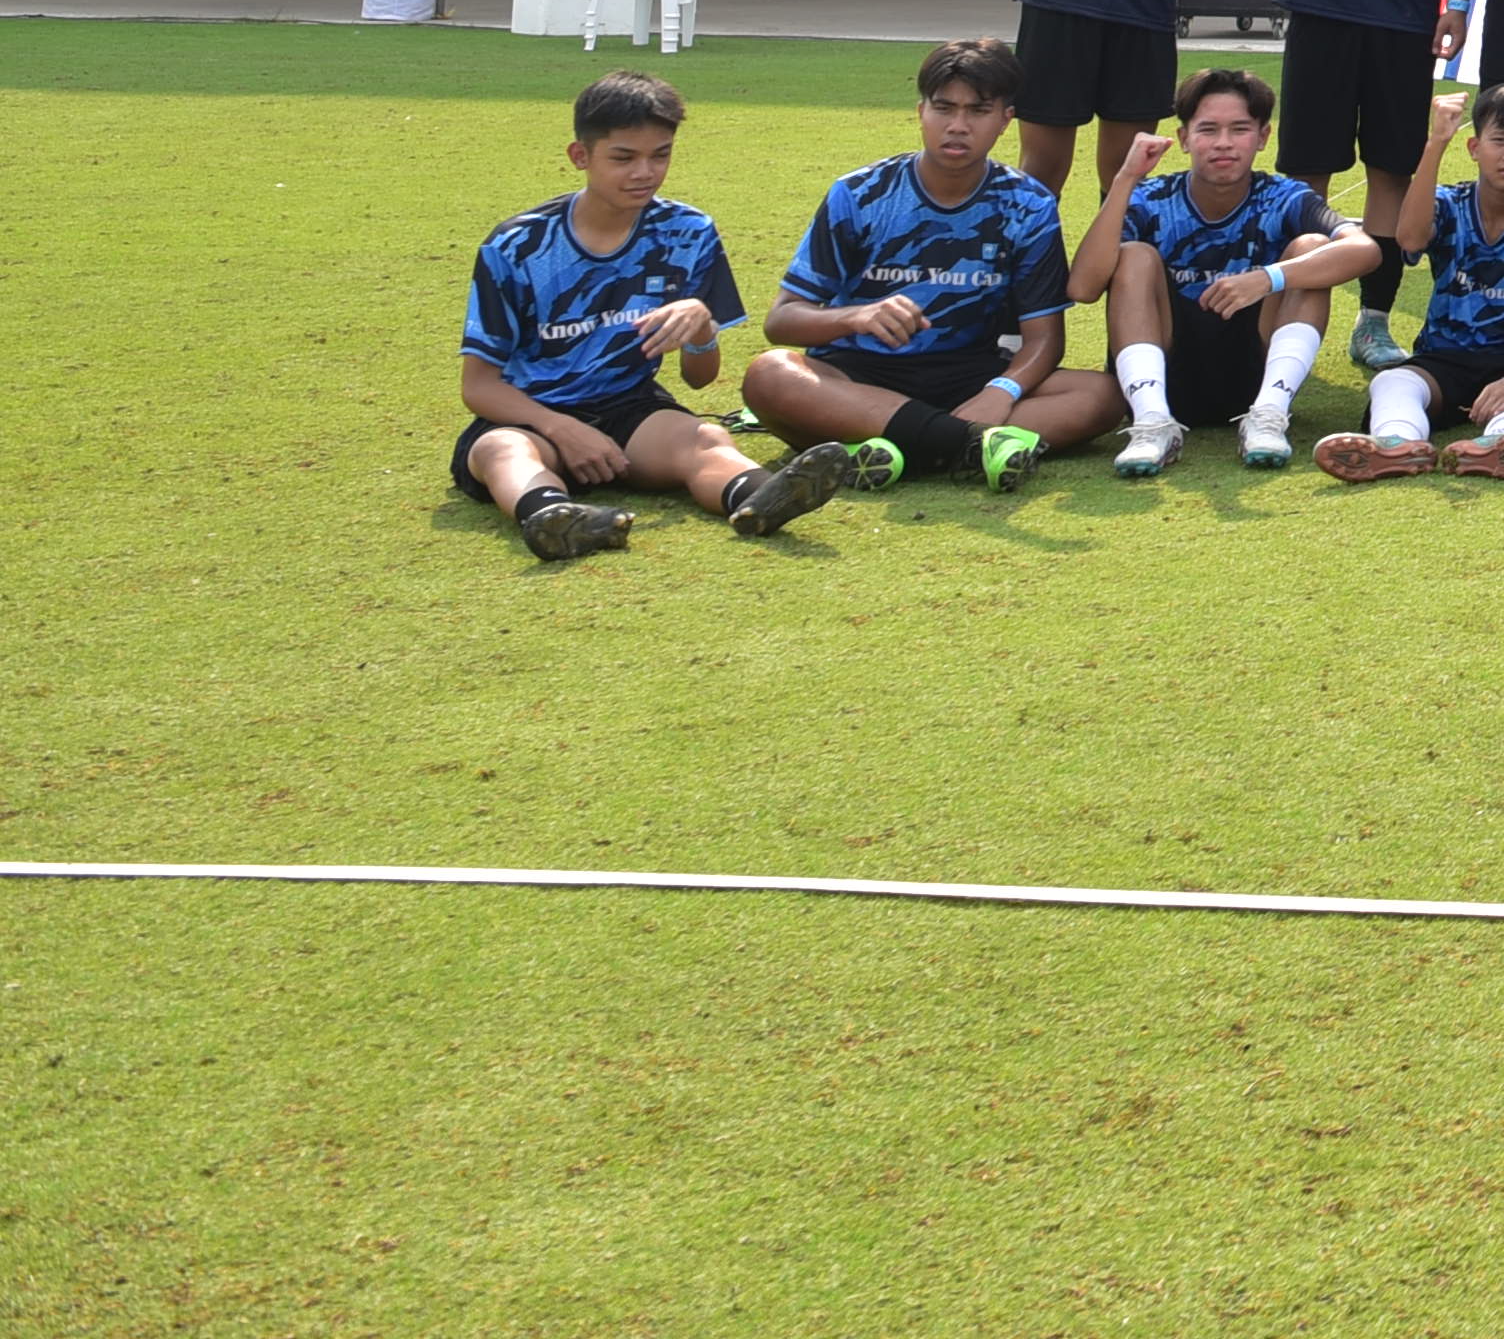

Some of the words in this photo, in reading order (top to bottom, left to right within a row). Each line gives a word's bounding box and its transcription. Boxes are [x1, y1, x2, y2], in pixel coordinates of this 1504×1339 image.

[862, 265, 925, 282] Know
[927, 266, 967, 287] You
[540, 314, 600, 340] Know
[600, 305, 640, 330] You
